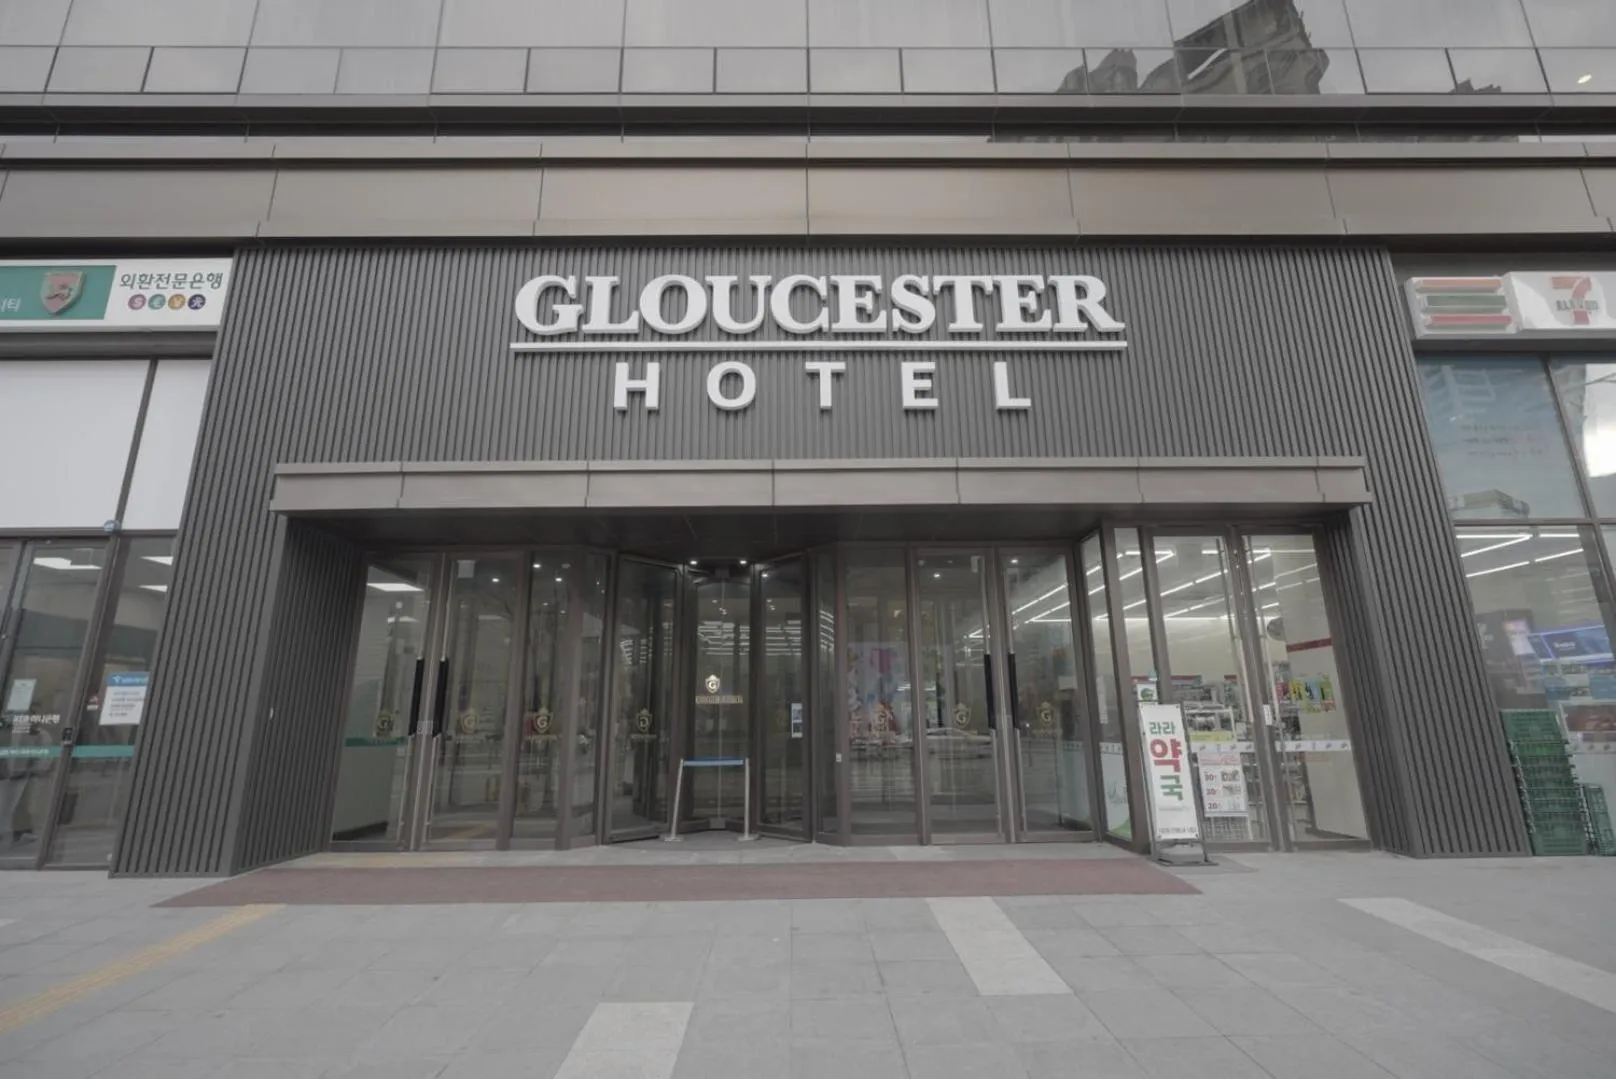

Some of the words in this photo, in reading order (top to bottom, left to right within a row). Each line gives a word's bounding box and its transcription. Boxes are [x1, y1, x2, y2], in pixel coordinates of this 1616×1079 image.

[119, 272, 223, 290] 외환전문은행
[514, 274, 1126, 335] GLOUCESTER
[613, 361, 1031, 411] HOTEL
[1150, 721, 1175, 735] 라라
[1150, 738, 1183, 801] 약국
